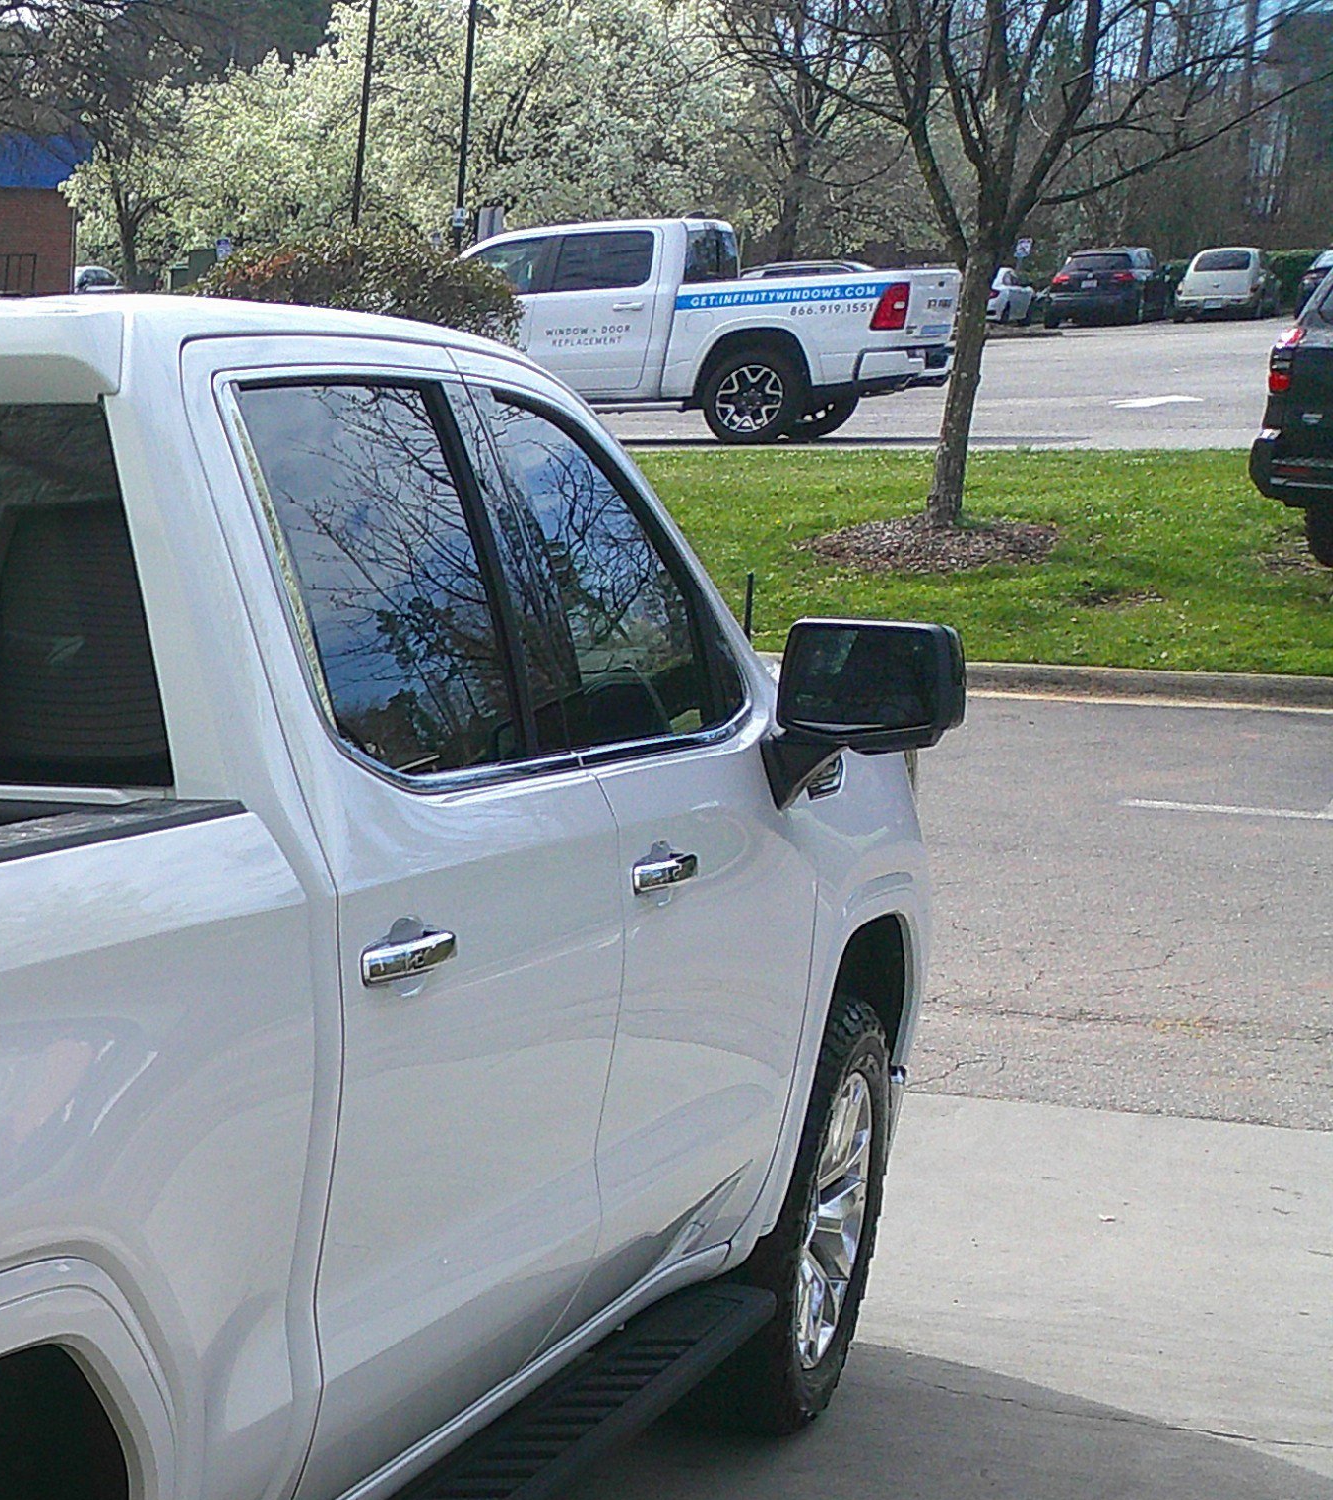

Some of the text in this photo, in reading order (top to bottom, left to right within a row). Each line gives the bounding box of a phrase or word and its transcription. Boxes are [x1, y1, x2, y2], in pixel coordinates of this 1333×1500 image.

[789, 302, 874, 316] 866.919.1551
[545, 325, 631, 336] WINDOW DOOR
[552, 336, 623, 347] REPLACEMENT
